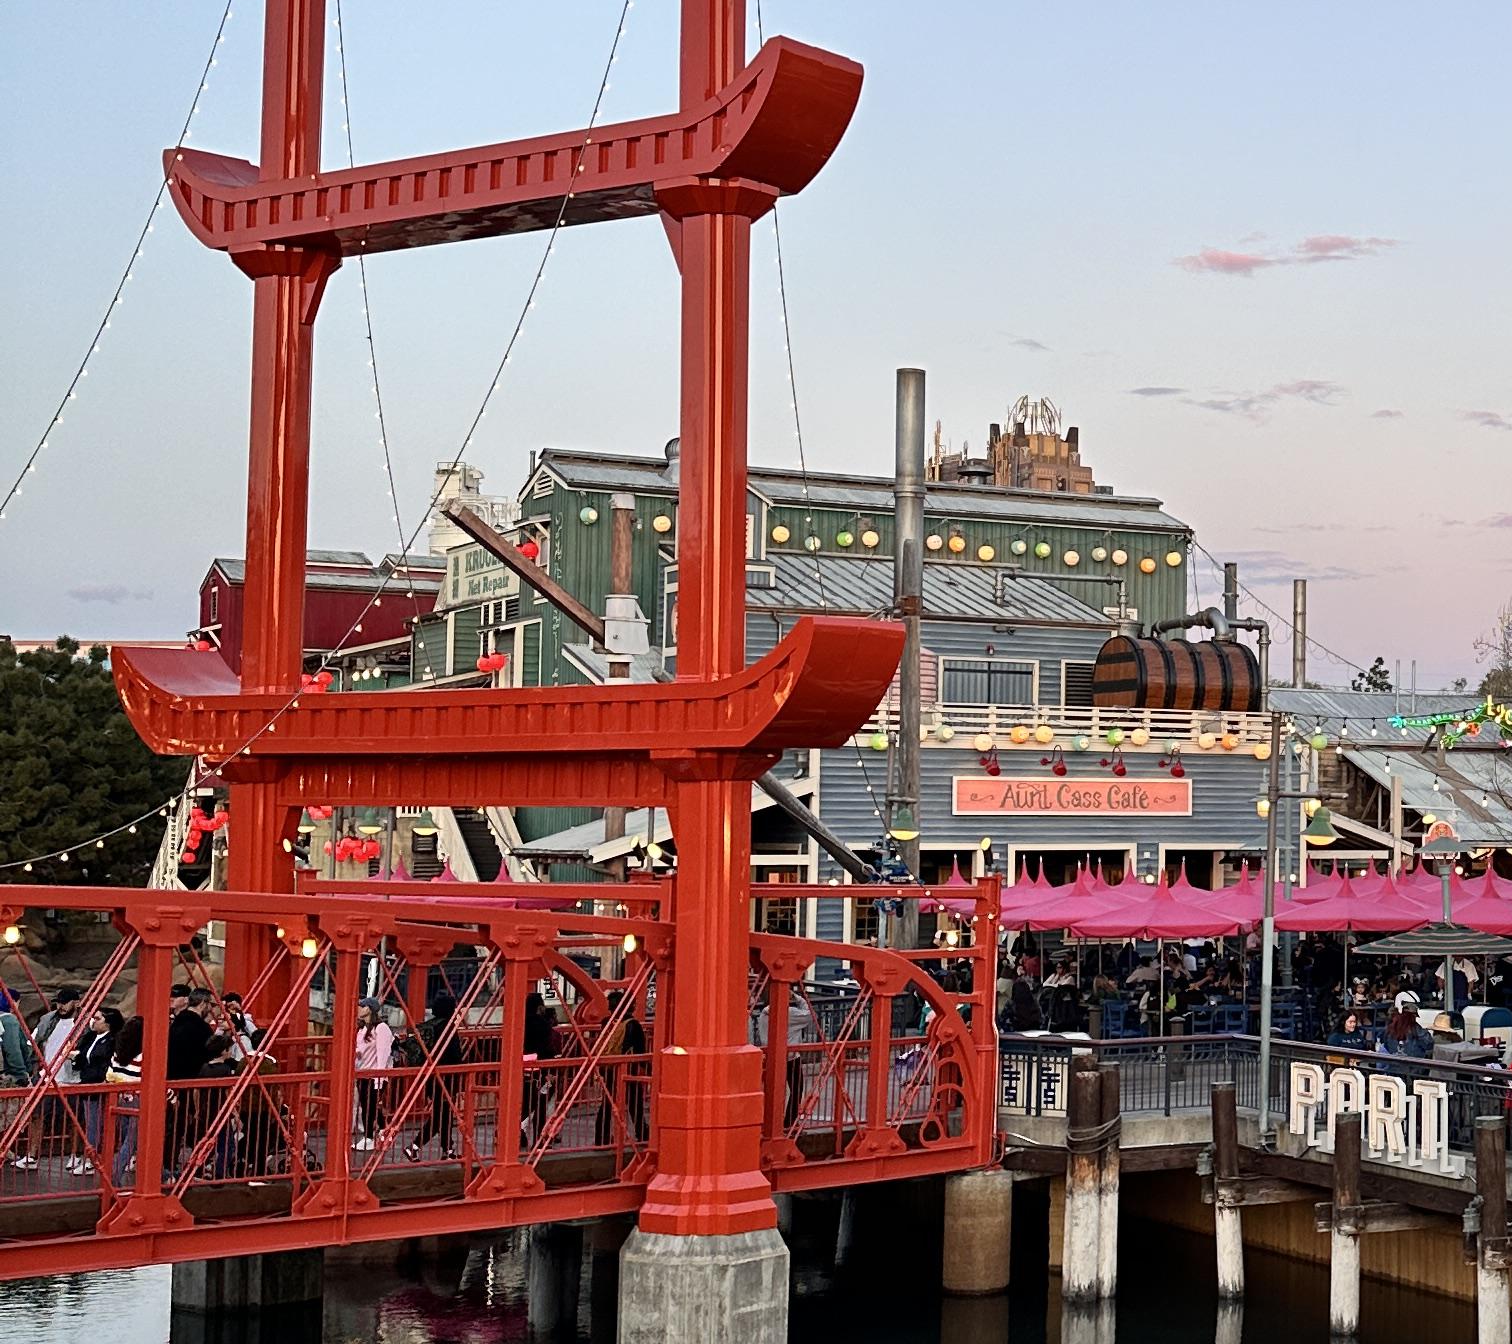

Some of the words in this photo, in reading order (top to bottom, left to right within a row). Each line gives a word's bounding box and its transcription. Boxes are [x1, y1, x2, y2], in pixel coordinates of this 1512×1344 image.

[483, 575, 509, 595] Repair
[1000, 782, 1053, 810] Aunt
[1056, 783, 1102, 810] Cass
[1290, 1061, 1448, 1160] PORT
